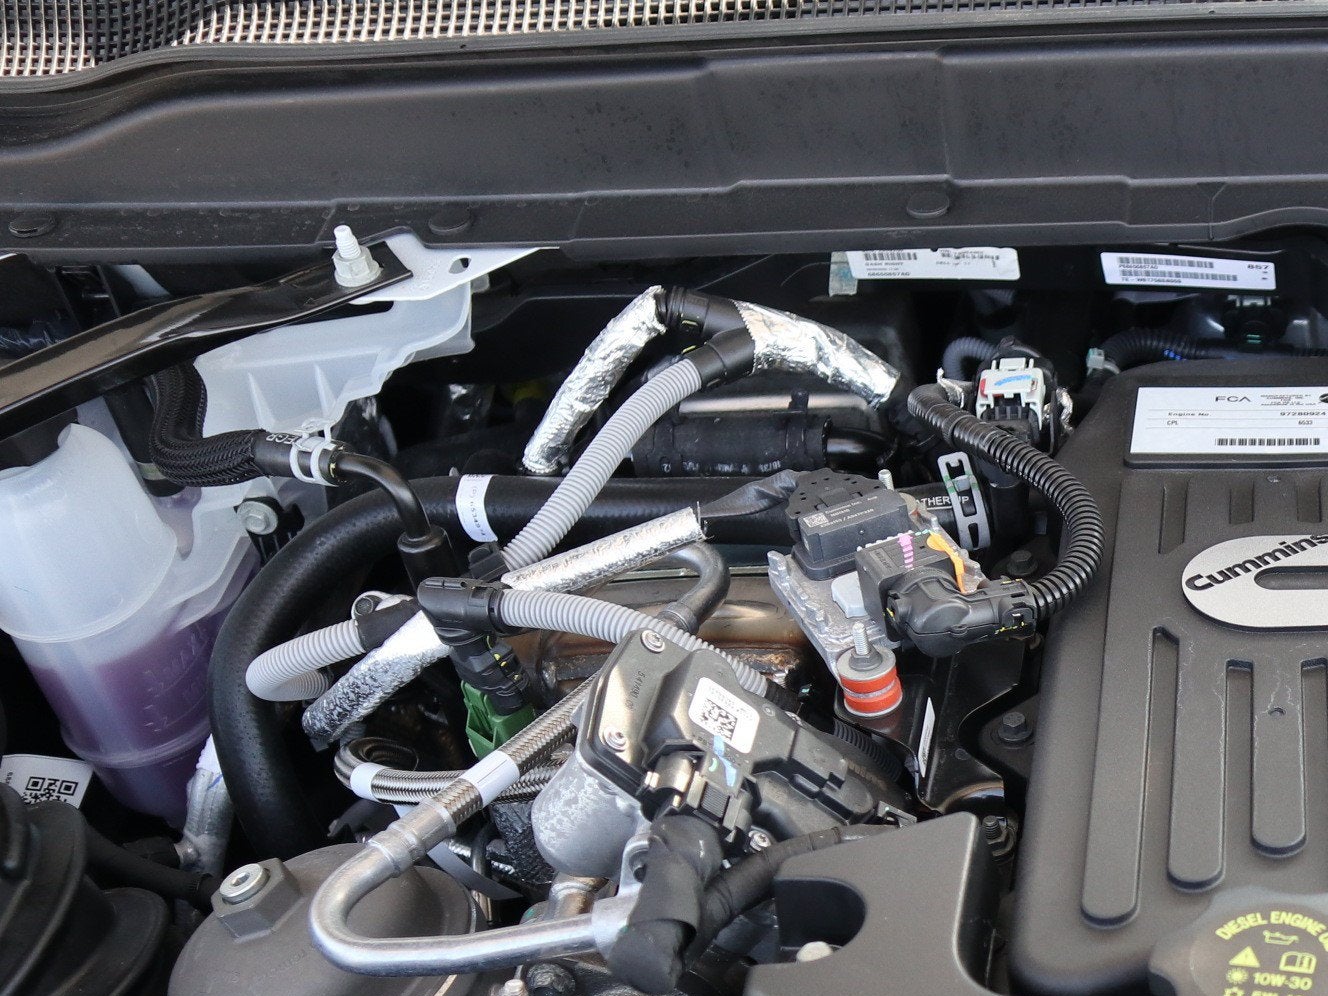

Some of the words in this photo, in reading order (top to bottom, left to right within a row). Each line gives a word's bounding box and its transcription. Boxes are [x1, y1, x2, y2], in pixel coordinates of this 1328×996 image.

[1215, 395, 1251, 403] FCA
[1215, 912, 1268, 940] DIESEL
[1270, 911, 1327, 936] ENGINE
[1253, 972, 1313, 991] 10W-30
